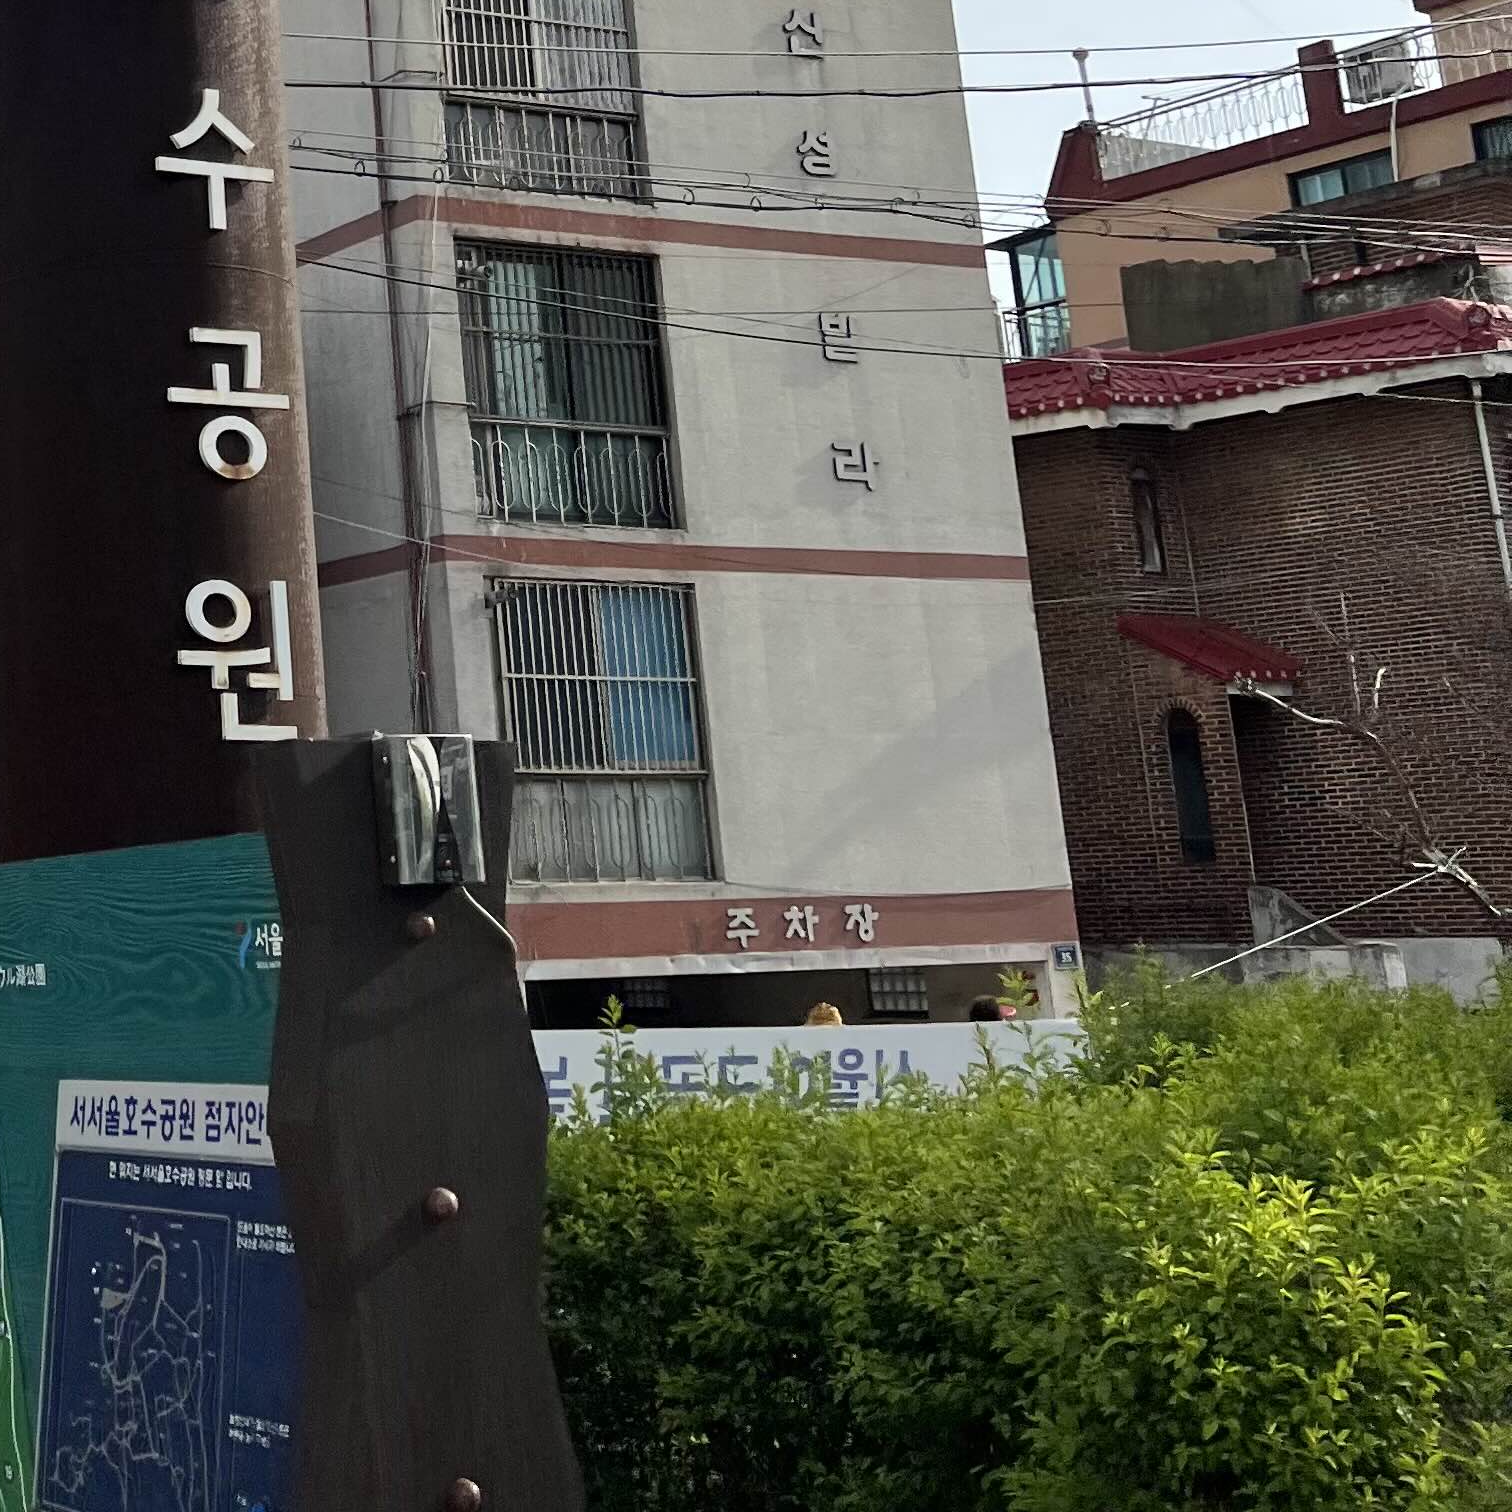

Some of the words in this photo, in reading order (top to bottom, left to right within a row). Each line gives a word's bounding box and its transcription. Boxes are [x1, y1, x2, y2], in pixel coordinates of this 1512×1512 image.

[725, 903, 880, 949] 주차장
[70, 1094, 196, 1142] 서서울호수공원
[204, 1099, 265, 1146] 점자안
